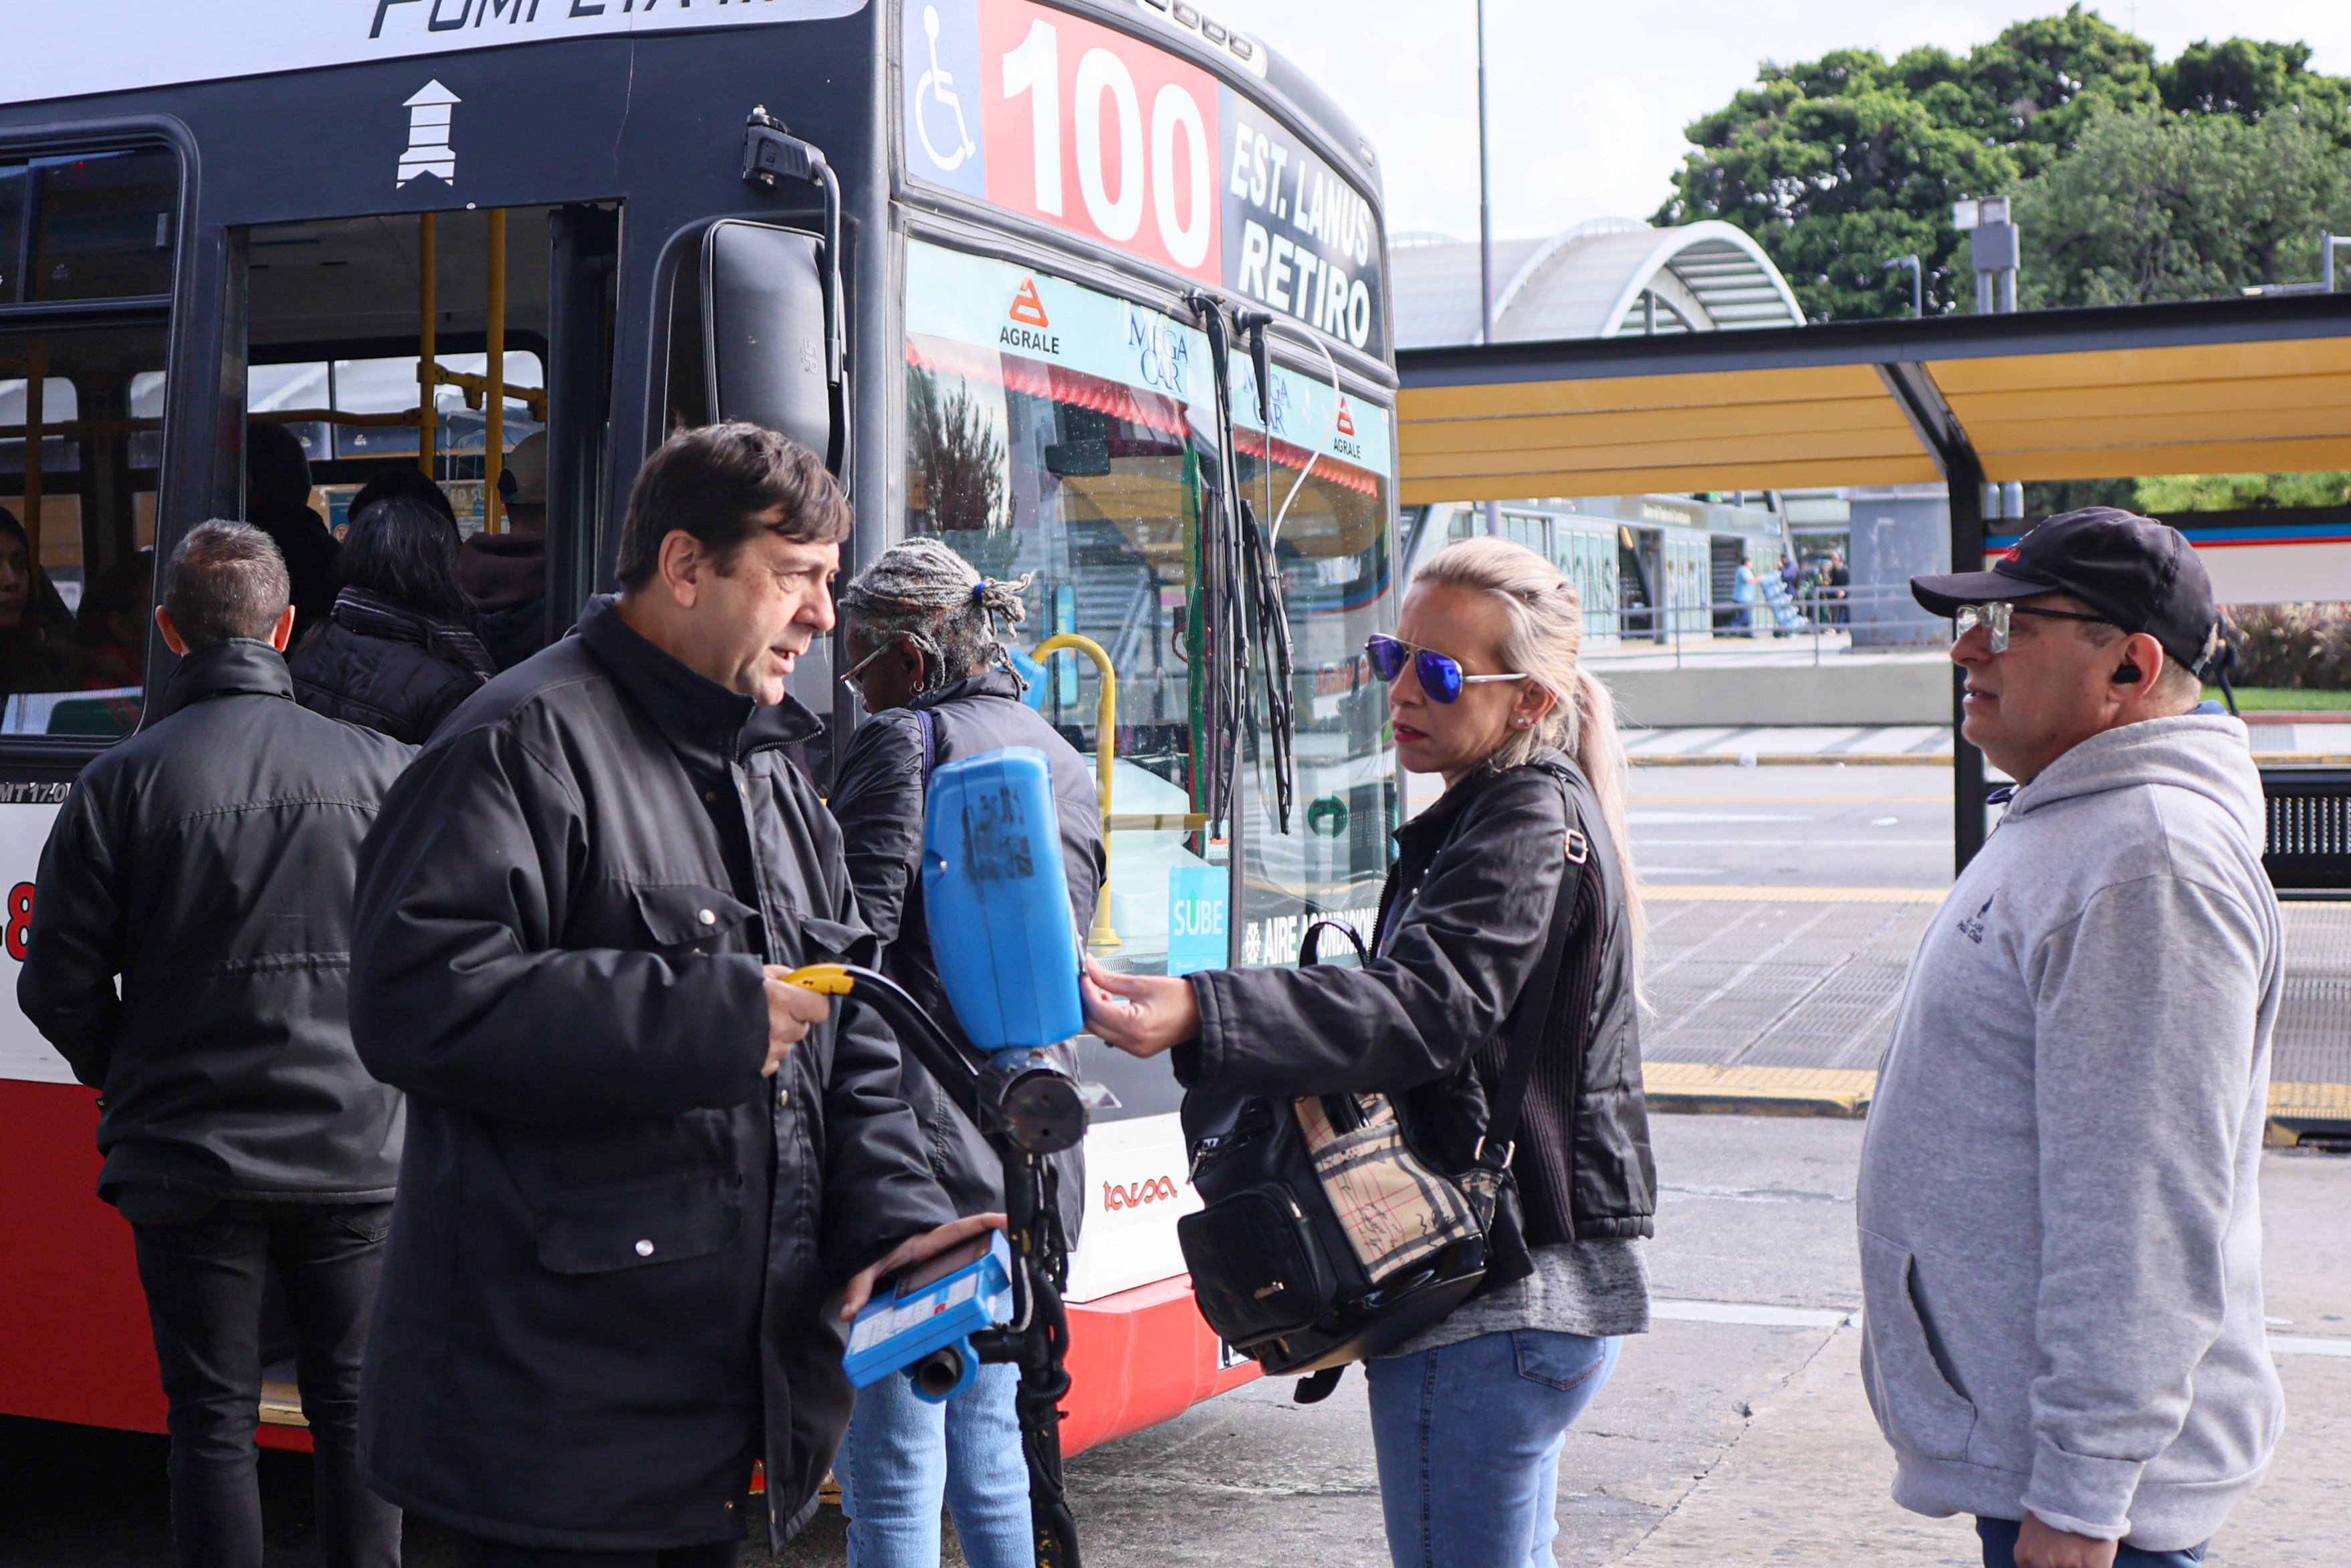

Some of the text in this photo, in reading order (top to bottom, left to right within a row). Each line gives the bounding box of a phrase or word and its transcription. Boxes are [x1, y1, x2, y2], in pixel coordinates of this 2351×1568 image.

[1003, 17, 1211, 269] 100
[1230, 122, 1370, 267] EST. LANUS
[1238, 219, 1371, 348] RETIRO
[1000, 326, 1060, 354] AGRALE
[1129, 312, 1188, 364] MEGA
[1141, 348, 1182, 393] CAR
[1243, 358, 1293, 409] MGA
[1334, 437, 1361, 459] AGRALE
[1174, 899, 1223, 936] SUBE
[1263, 915, 1297, 966] AIRE
